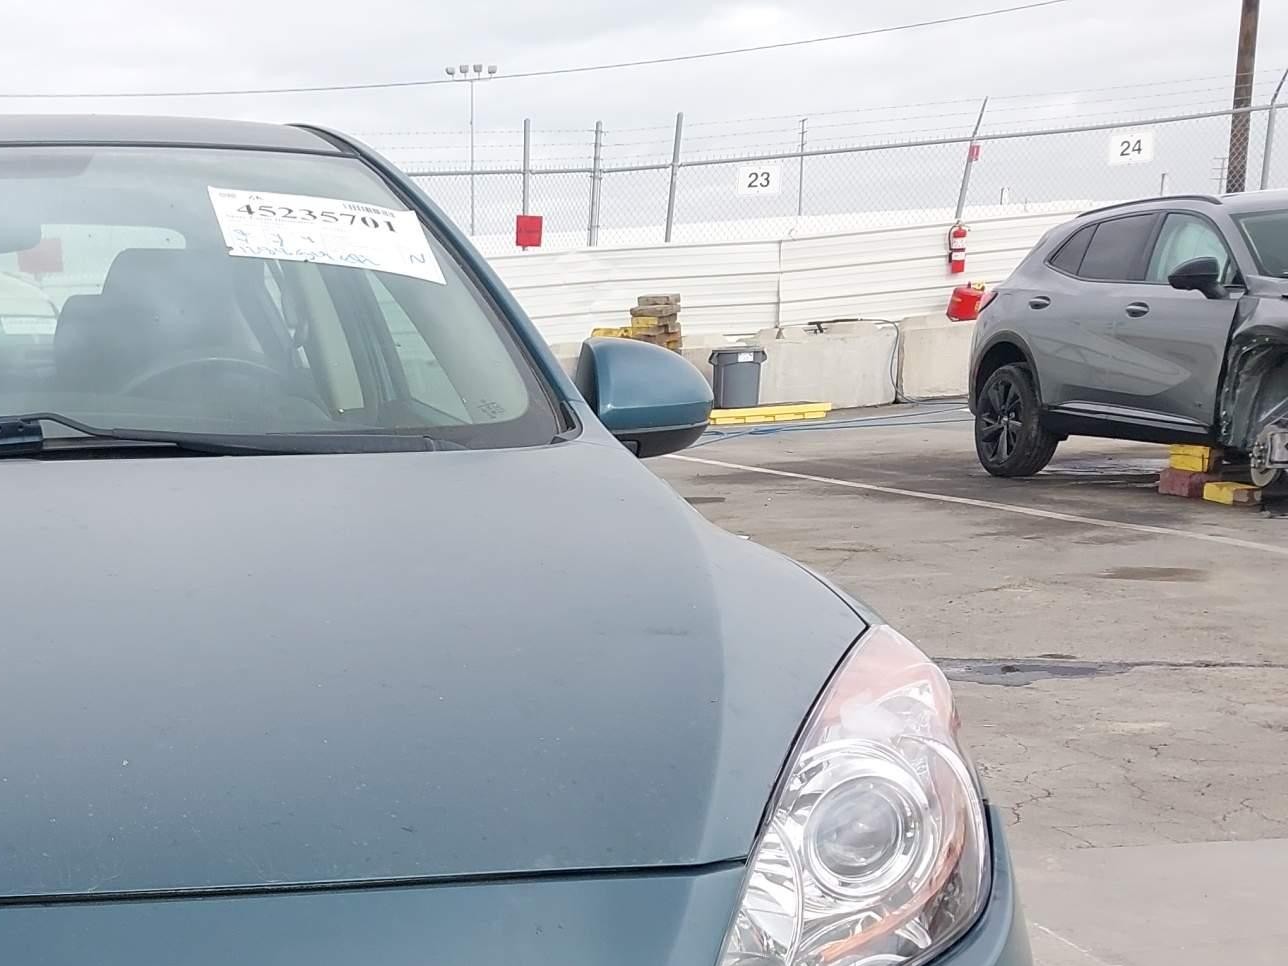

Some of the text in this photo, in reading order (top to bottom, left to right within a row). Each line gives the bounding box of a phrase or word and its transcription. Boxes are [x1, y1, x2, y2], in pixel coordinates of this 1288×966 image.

[1119, 139, 1142, 156] 24
[747, 171, 770, 188] 23
[236, 203, 397, 233] 45235701
